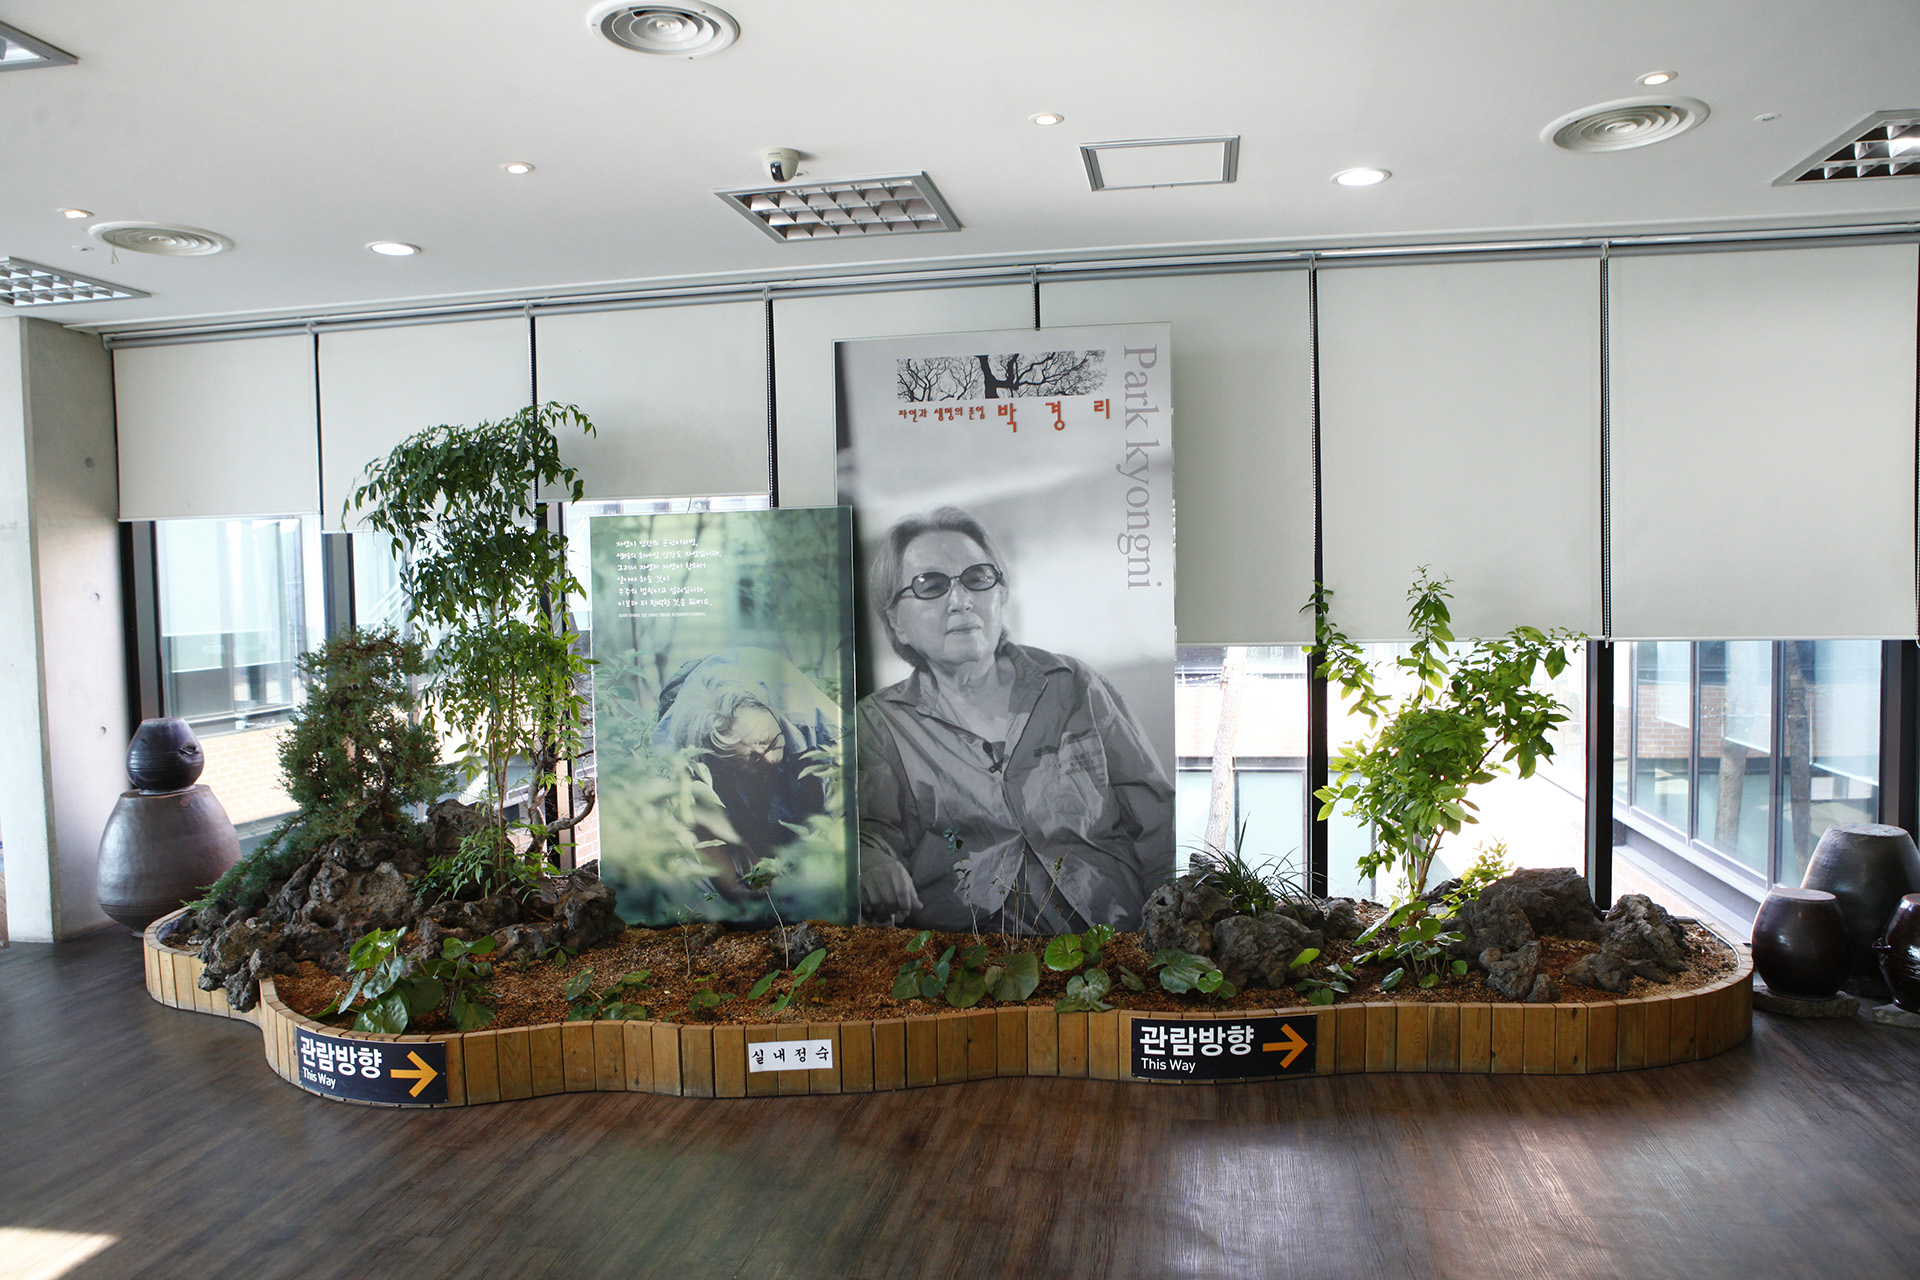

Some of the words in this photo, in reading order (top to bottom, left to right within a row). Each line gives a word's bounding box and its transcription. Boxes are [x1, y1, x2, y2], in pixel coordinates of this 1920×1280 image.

[1123, 344, 1159, 429] Park
[898, 408, 927, 422] 자연과
[934, 407, 963, 421] 생명의
[968, 406, 985, 420] 존엄
[1116, 439, 1163, 590] kyongni
[1139, 1025, 1254, 1056] 관람방향
[300, 1036, 383, 1079] 관람방향
[1141, 1057, 1167, 1070] This
[1169, 1059, 1196, 1073] Way
[302, 1067, 317, 1084] This
[317, 1072, 336, 1090] Way
